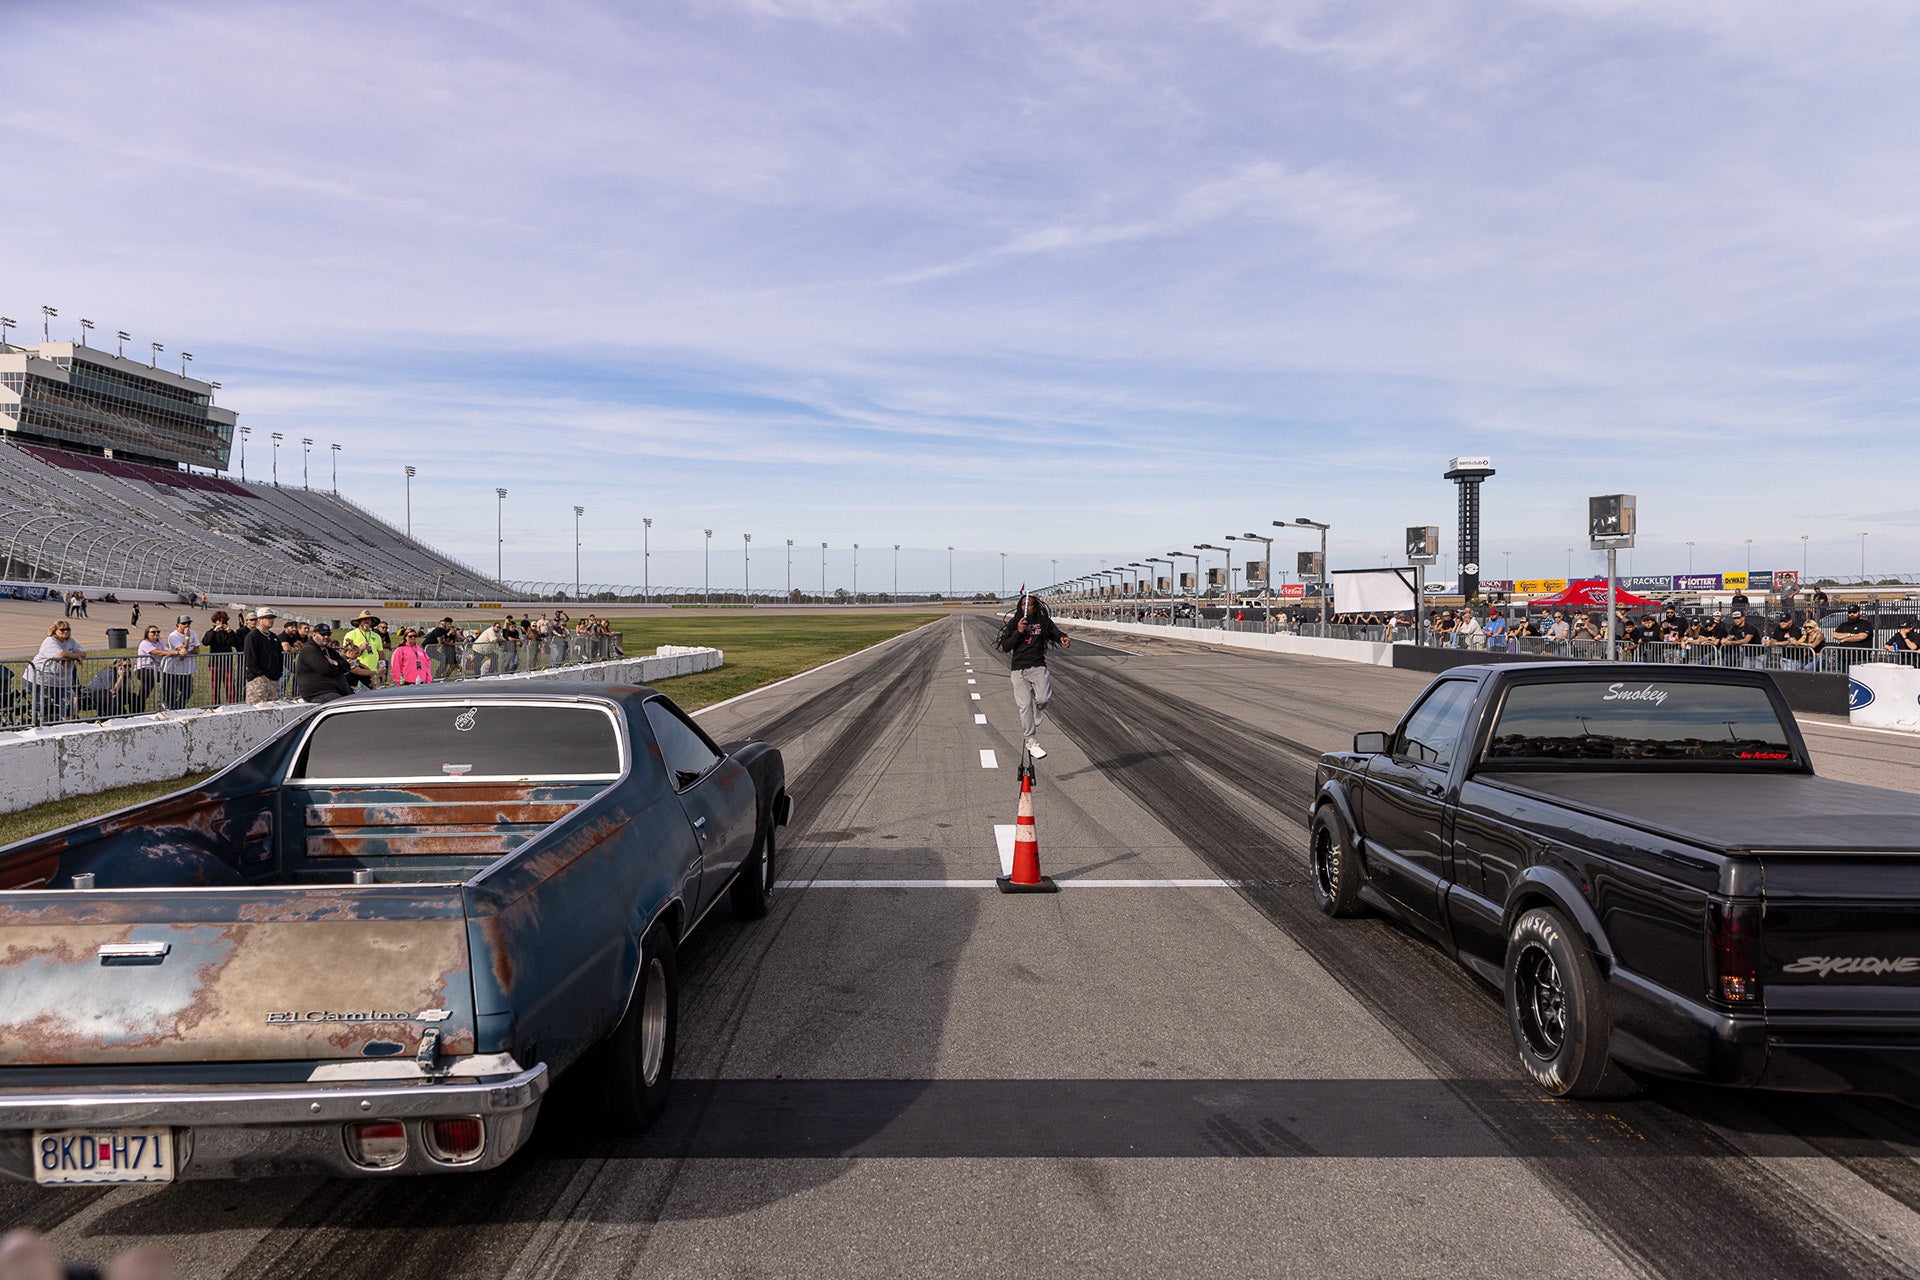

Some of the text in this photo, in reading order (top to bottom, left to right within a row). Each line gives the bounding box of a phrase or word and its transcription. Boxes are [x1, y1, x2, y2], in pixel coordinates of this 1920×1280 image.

[1633, 577, 1670, 585] RACKLEY
[1687, 577, 1716, 586] LOTTERY
[1603, 682, 1668, 706] Smokey
[1782, 956, 1920, 978] SYCLONE
[266, 1010, 410, 1023] El Camino
[41, 1135, 163, 1170] 8KD H71
